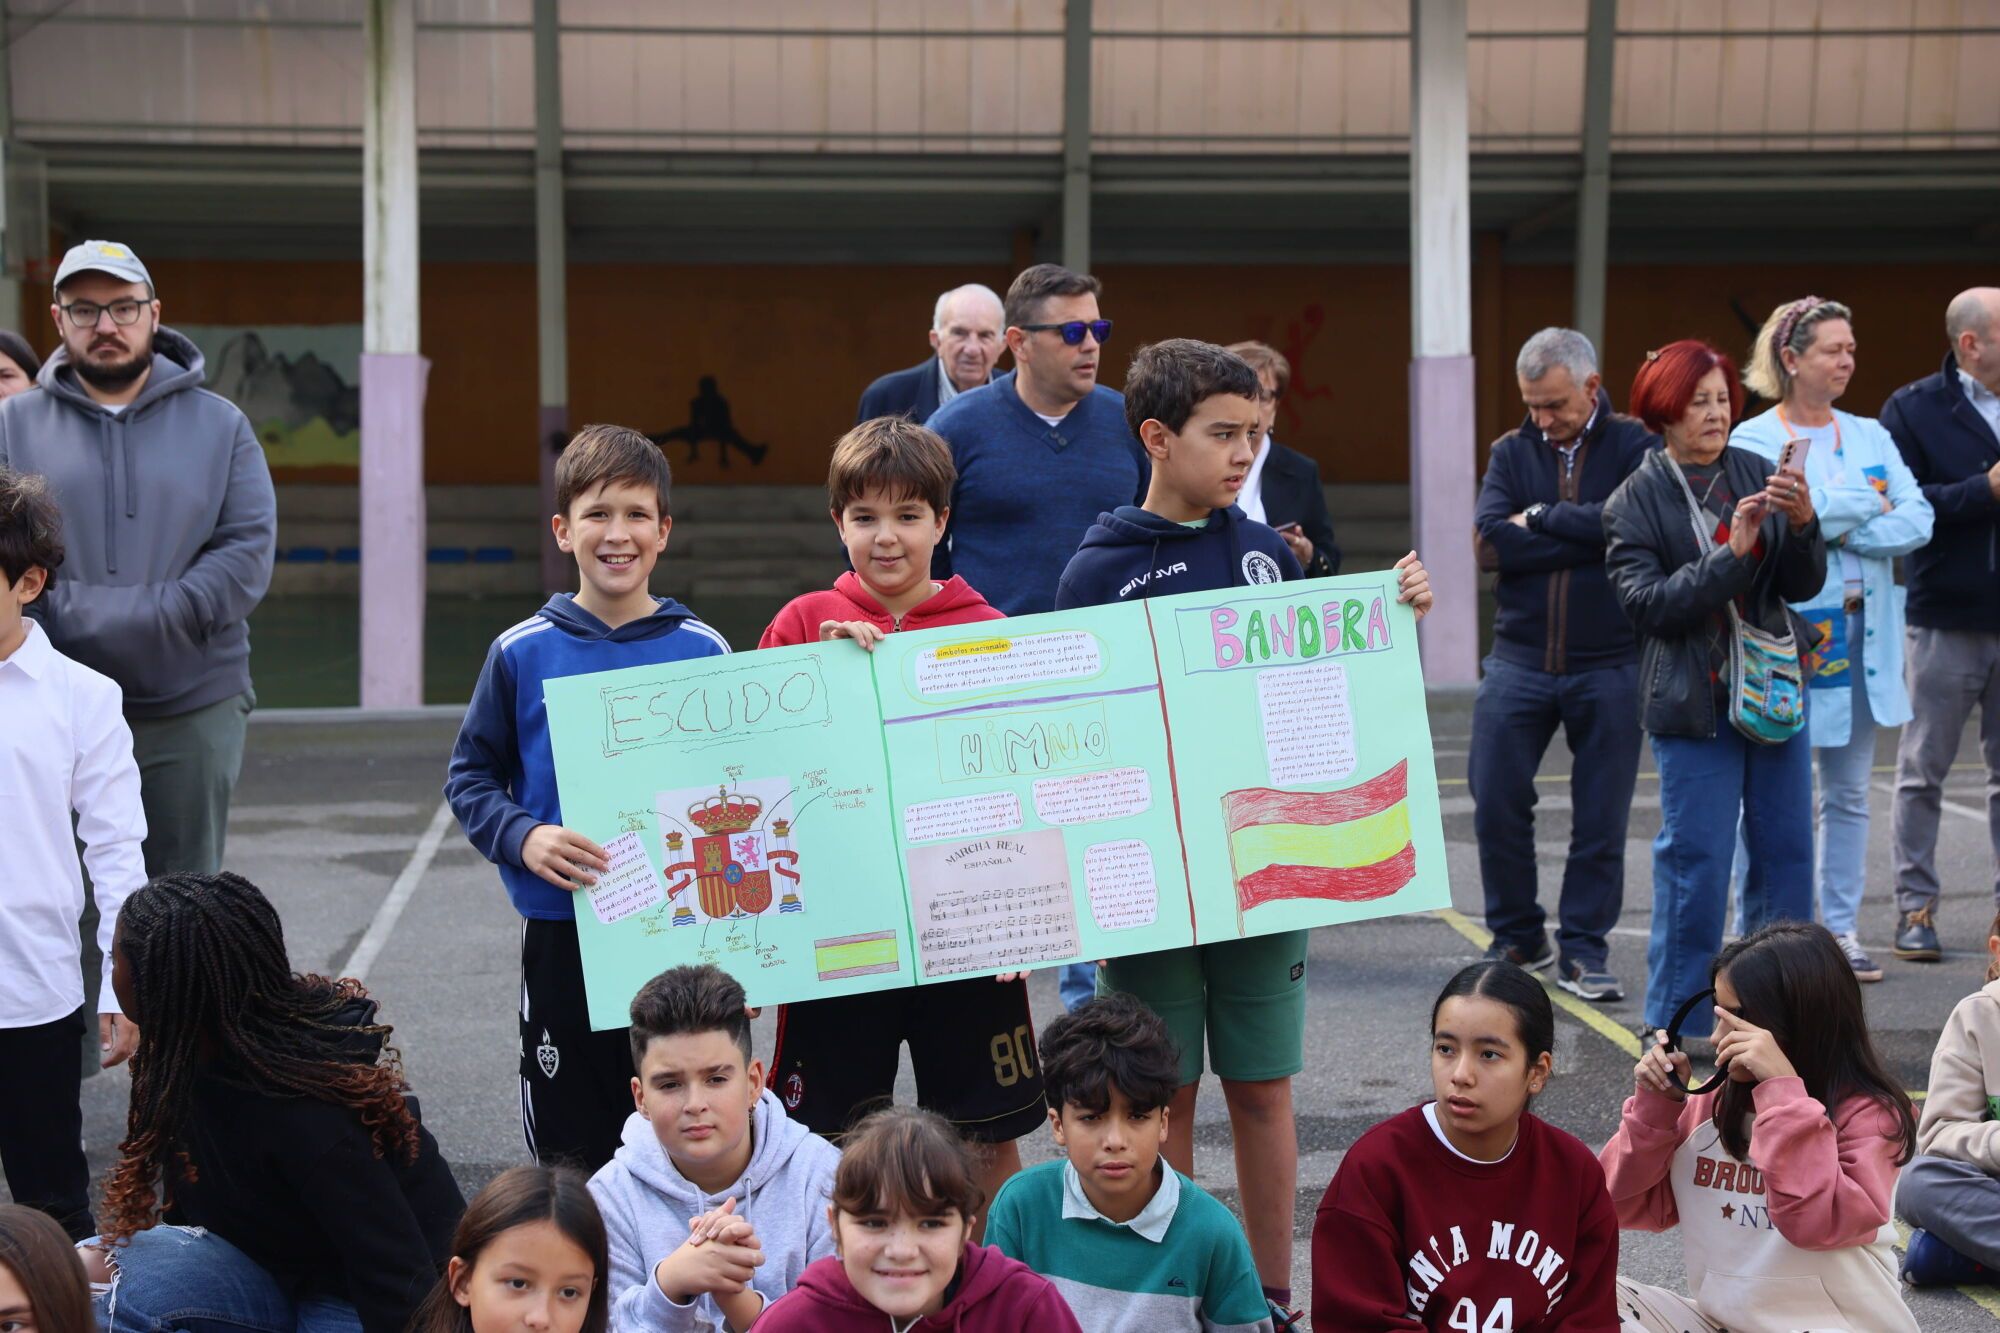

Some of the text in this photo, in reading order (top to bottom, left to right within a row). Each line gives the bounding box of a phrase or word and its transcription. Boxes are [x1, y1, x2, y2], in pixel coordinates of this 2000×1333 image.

[1210, 597, 1388, 668] BANDERA
[608, 672, 815, 743] ESCUDO
[603, 832, 636, 851] ran parte
[627, 841, 638, 851] del
[945, 840, 1027, 865] MARCHA REAL
[612, 852, 646, 872] elementos
[964, 856, 1013, 869] ESPAÑOLA
[590, 885, 602, 896] que
[612, 864, 648, 884] componen
[594, 873, 652, 907] poseen una larga
[599, 883, 658, 914] tradición de más
[618, 905, 637, 917] nueve
[638, 895, 657, 908] siglos
[990, 1023, 1035, 1088] 80
[1693, 1155, 1766, 1195] BROO
[1447, 1297, 1514, 1333] 94
